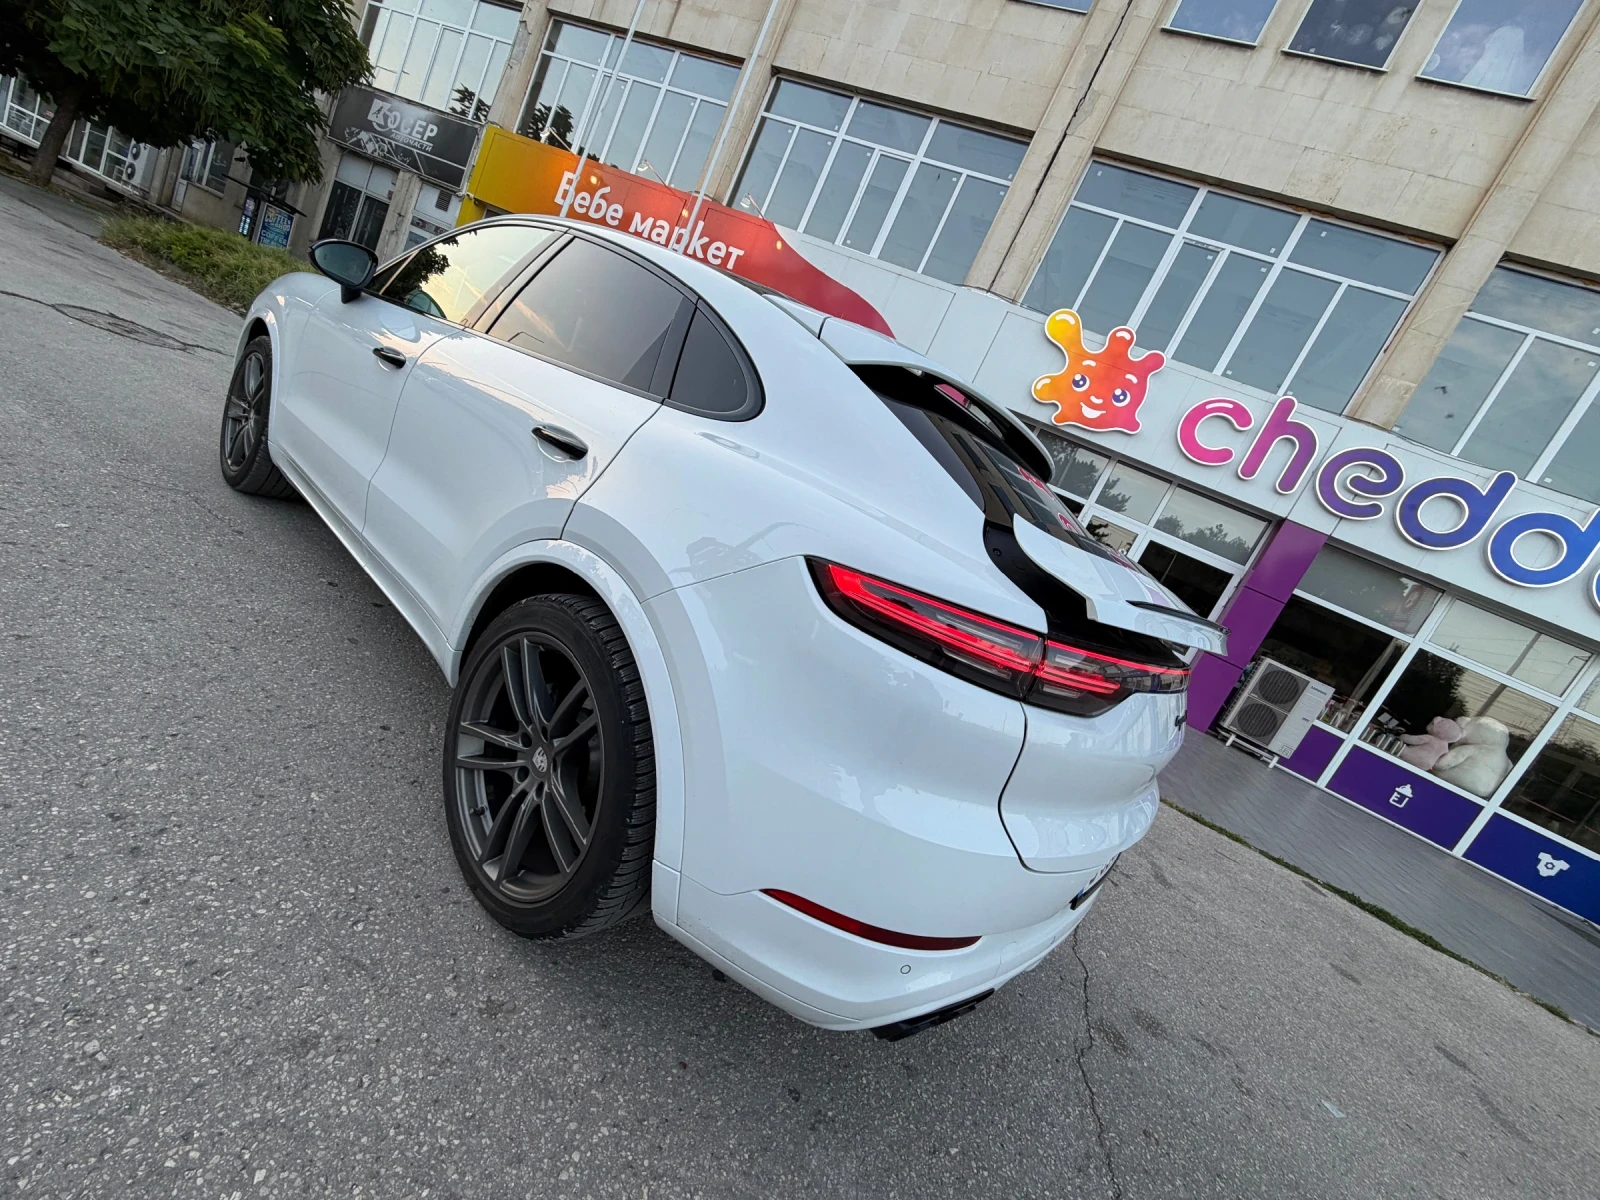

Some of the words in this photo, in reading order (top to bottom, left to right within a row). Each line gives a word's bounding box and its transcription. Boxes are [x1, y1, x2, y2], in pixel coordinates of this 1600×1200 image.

[389, 133, 433, 152] АВТОЧАСТИ
[554, 171, 623, 226] Бебе
[628, 220, 744, 270] маркет
[1177, 396, 1600, 612] chedd
